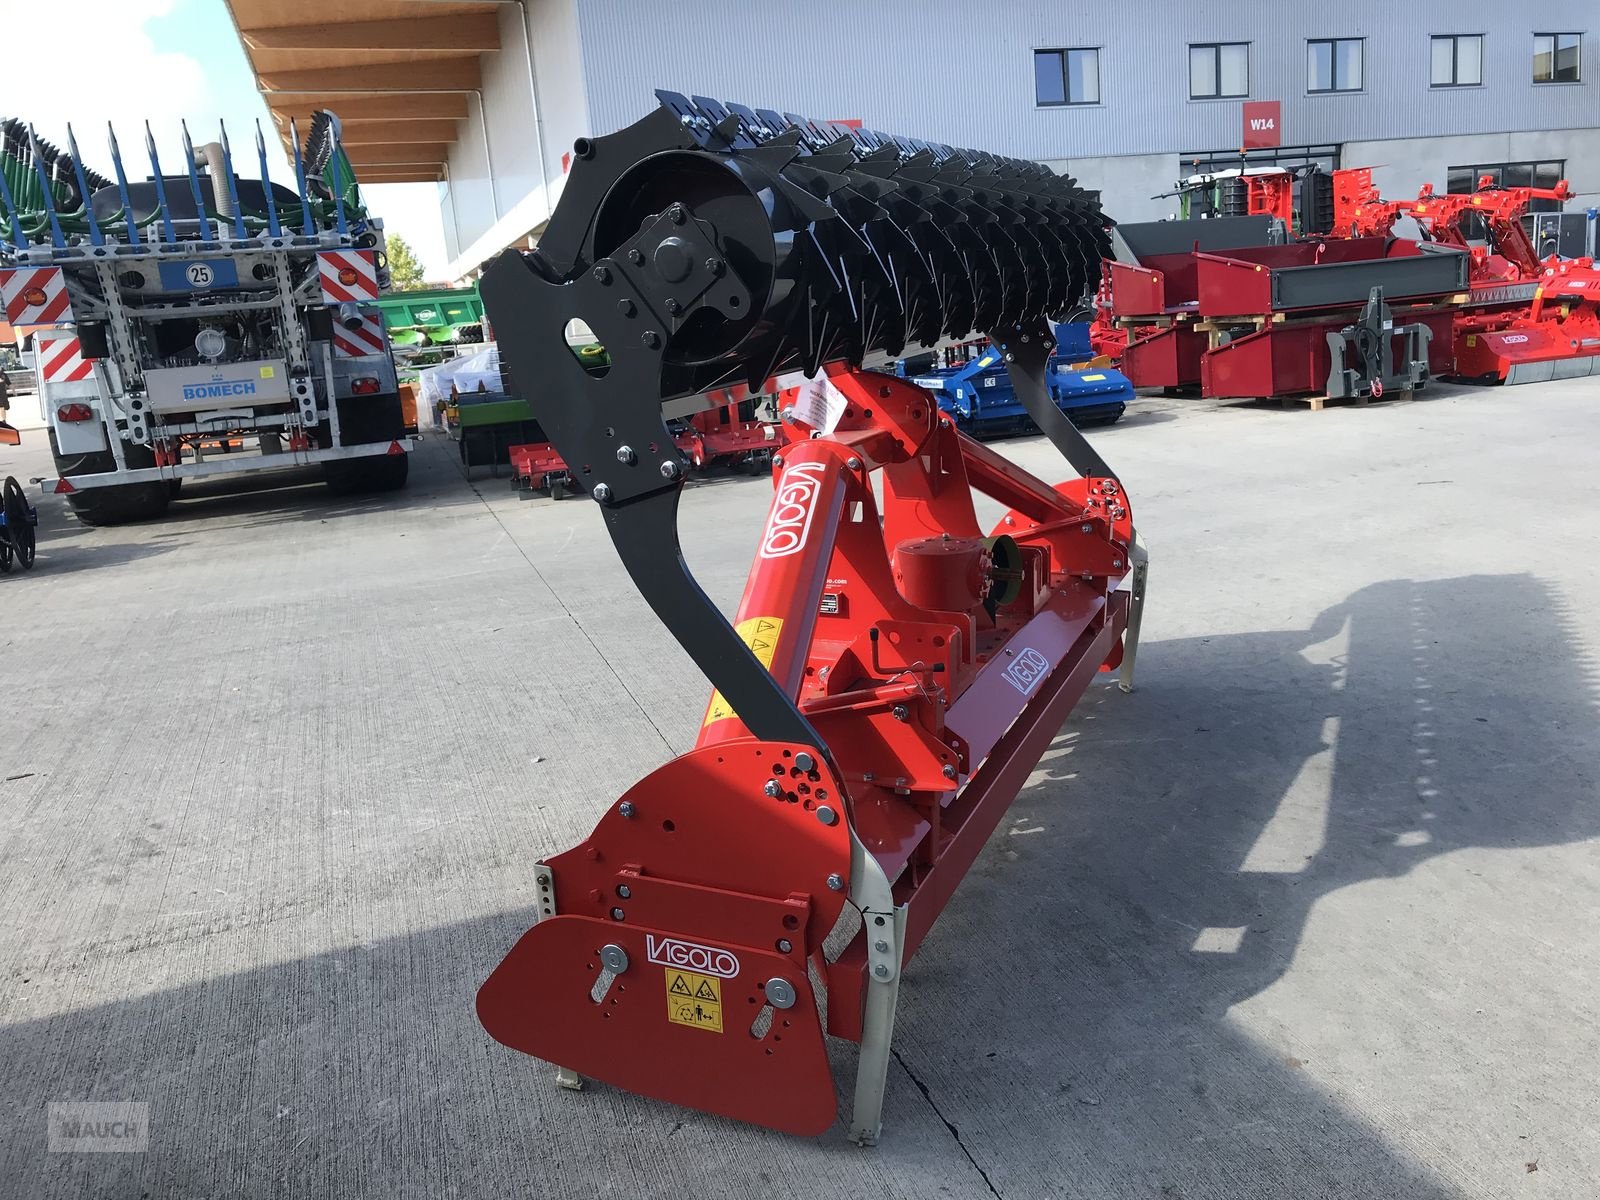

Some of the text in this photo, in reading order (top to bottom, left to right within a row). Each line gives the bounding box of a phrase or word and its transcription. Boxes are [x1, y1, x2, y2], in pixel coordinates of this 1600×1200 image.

[1250, 118, 1275, 131] W14
[191, 267, 209, 282] 25
[183, 382, 256, 400] BOMECH
[760, 461, 826, 559] VIGOLO
[1001, 647, 1050, 696] VIGOLO
[646, 934, 740, 979] VIGOLO
